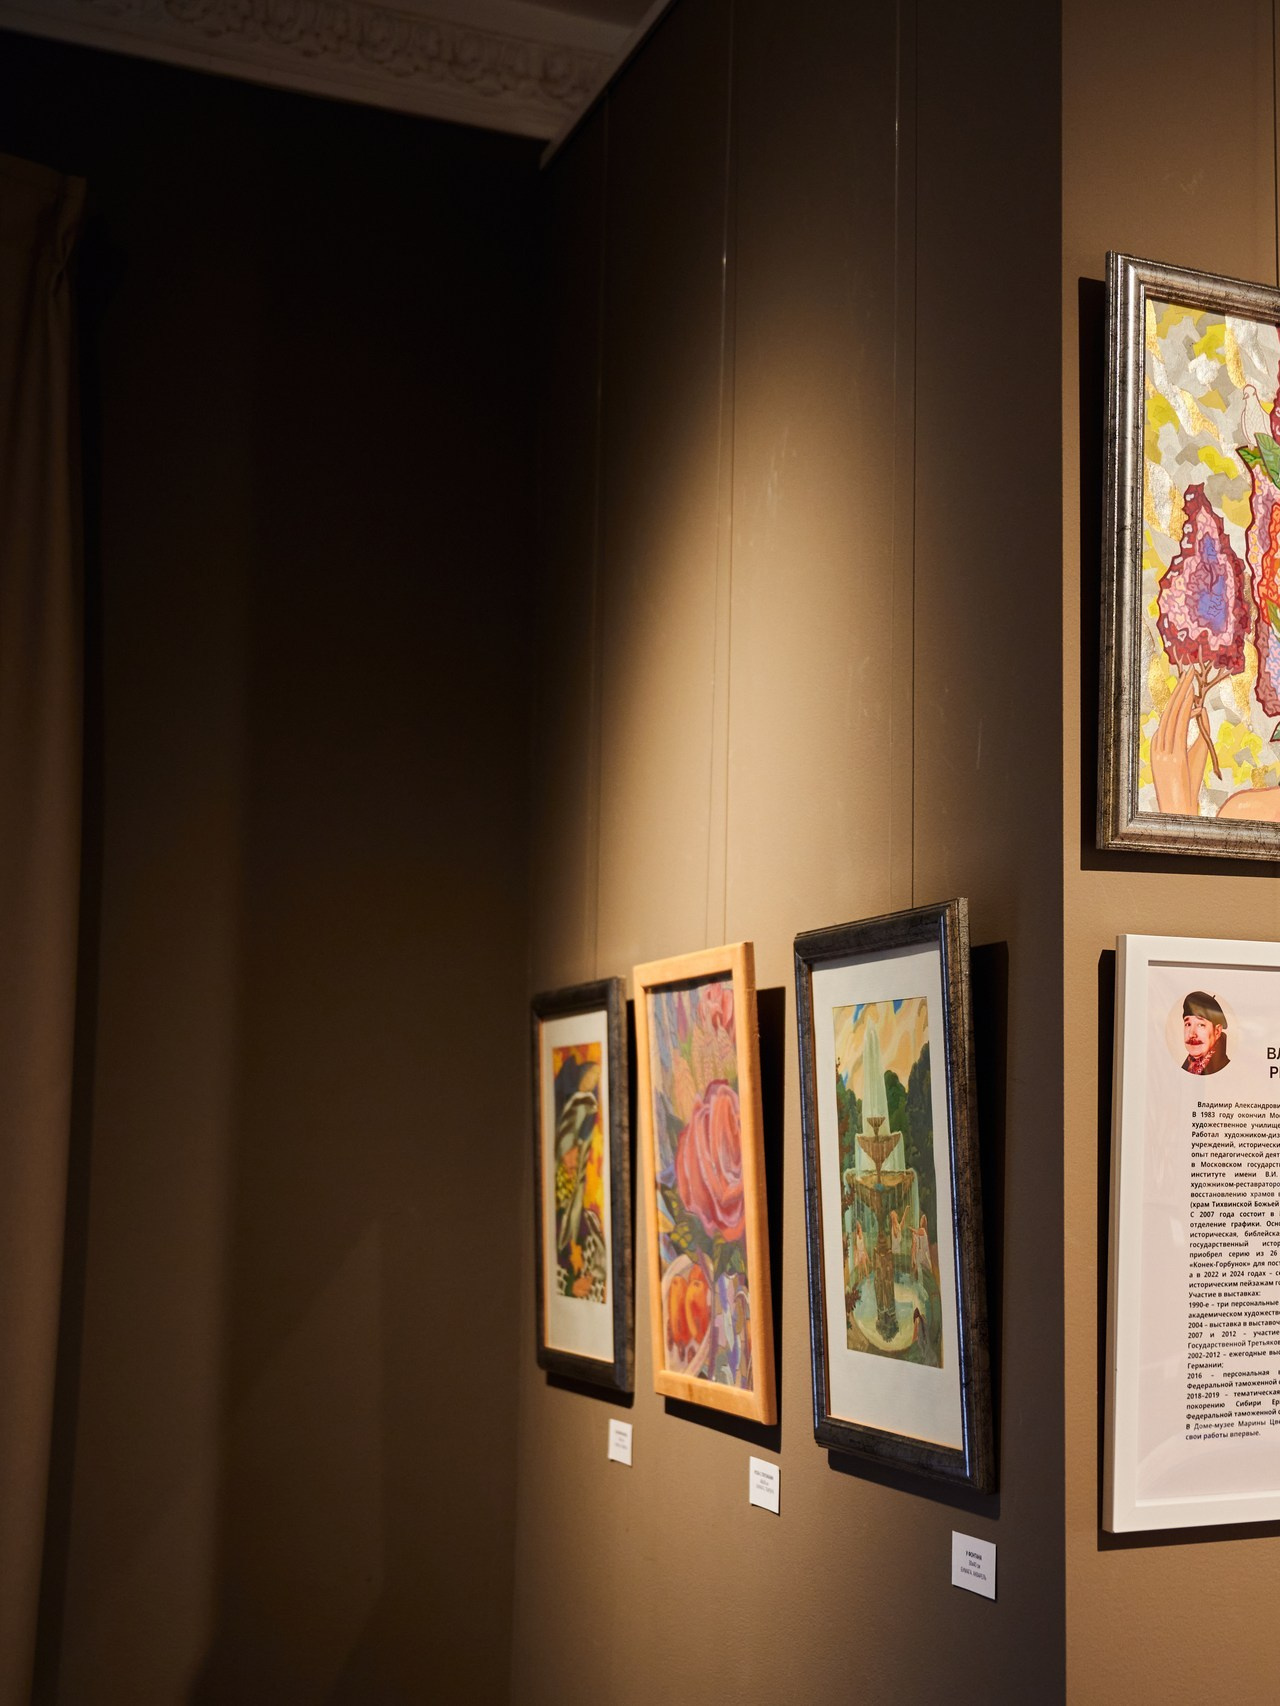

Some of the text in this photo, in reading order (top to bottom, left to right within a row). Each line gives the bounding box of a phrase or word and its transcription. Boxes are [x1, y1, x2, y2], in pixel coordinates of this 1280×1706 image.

[1197, 1101, 1233, 1110] Владимир
[1191, 1141, 1236, 1149] учреждений,
[1210, 1151, 1264, 1159] педагогической
[1190, 1201, 1210, 1209] (храм
[1231, 1220, 1262, 1229] графики.
[1189, 1231, 1239, 1239] историческая,
[1189, 1240, 1249, 1249] государственный
[1189, 1251, 1223, 1259] приобрел
[1228, 1251, 1250, 1259] серию
[1189, 1260, 1251, 1269] «Конек-Горбунок»
[1239, 1279, 1274, 1287] пейзажам
[1189, 1301, 1210, 1309] 1990-е
[1188, 1321, 1203, 1329] 2004
[1187, 1331, 1203, 1339] 2007
[1187, 1372, 1203, 1380] 2016
[1235, 1378, 1277, 1387] таможенной
[1235, 1399, 1262, 1409] Сибири
